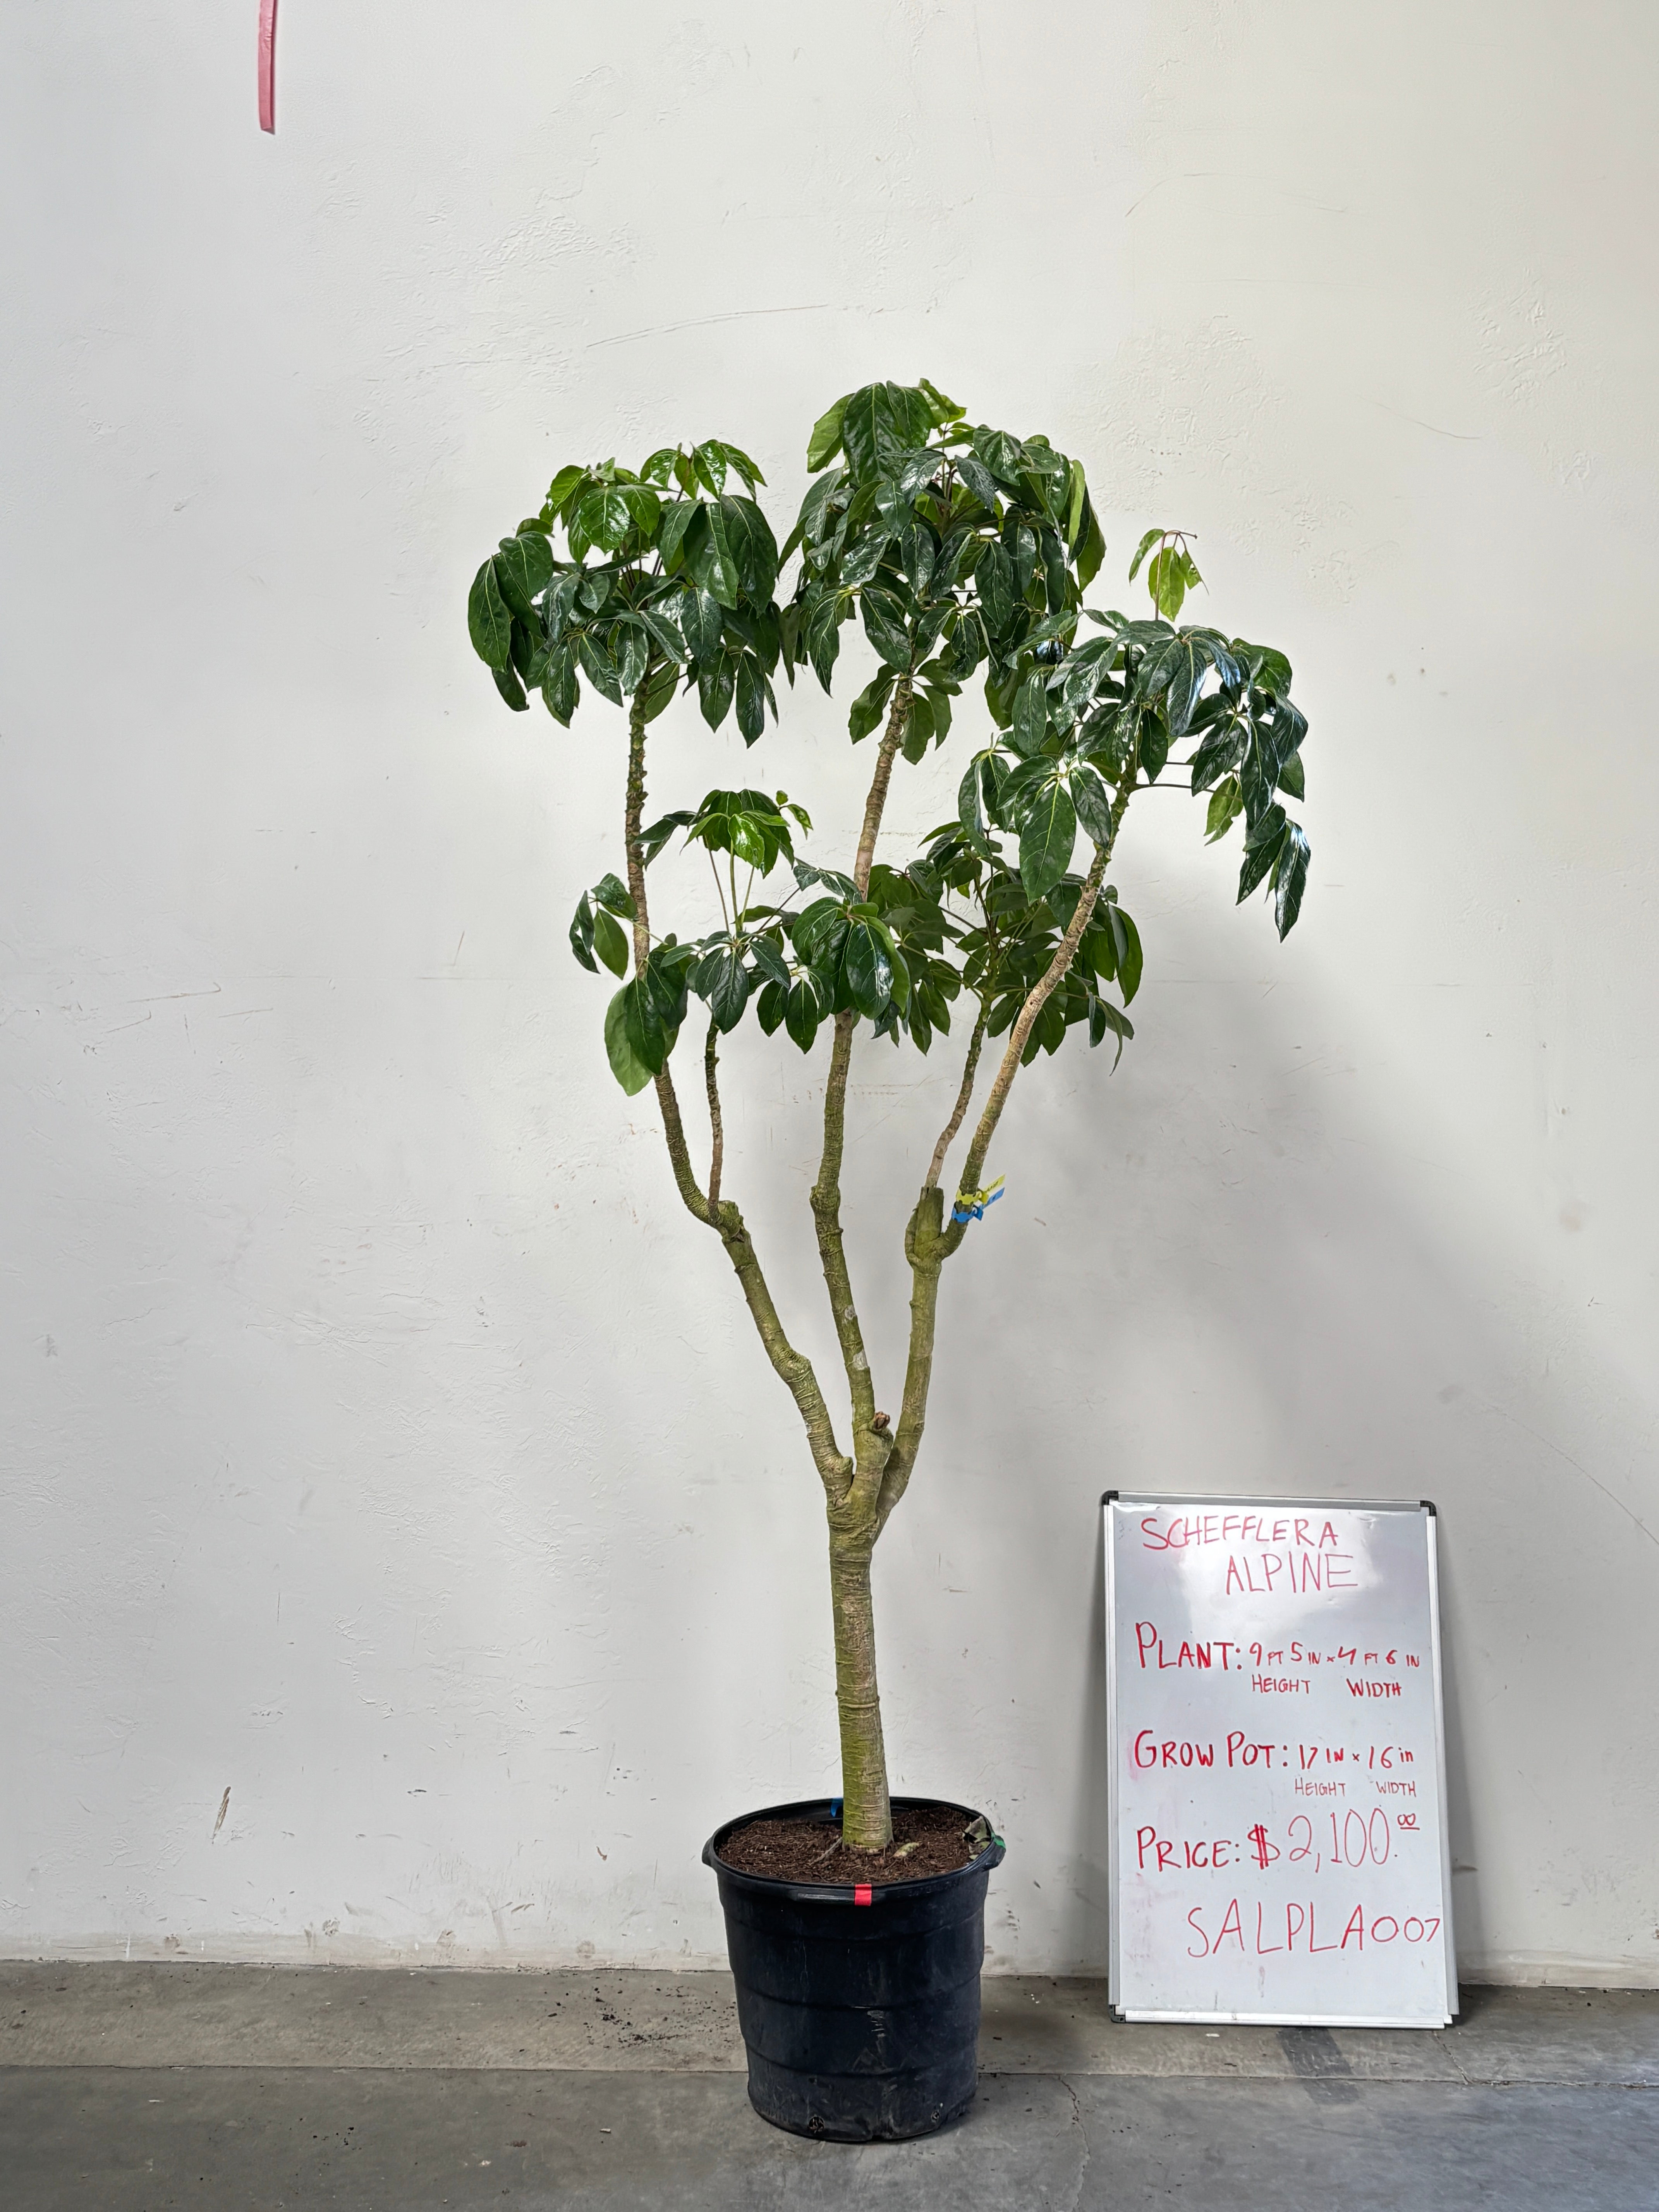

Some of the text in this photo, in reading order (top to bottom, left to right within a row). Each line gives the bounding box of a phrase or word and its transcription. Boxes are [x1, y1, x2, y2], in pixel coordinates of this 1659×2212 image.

[1140, 1516, 1337, 1551] SCHEFFLERA
[1226, 1552, 1358, 1595] ALPINE
[1135, 1622, 1242, 1671] PLANT:
[1249, 1642, 1262, 1667] 9
[1290, 1642, 1303, 1662] 5
[1308, 1652, 1321, 1665] IN
[1337, 1647, 1357, 1664] 4
[1364, 1652, 1378, 1664] FT
[1385, 1649, 1398, 1665] 6
[1406, 1656, 1419, 1667] IN
[1252, 1674, 1402, 1698] HEIGHT WIDTH
[1133, 1730, 1214, 1769] GROW
[1226, 1731, 1287, 1769] POT:
[1299, 1745, 1318, 1769] 17
[1326, 1748, 1344, 1763] IN
[1369, 1746, 1394, 1769] 16
[1398, 1747, 1414, 1762] in
[1295, 1777, 1417, 1797] HEIGHT WIDTH
[1137, 1826, 1239, 1872] PRICE:
[1187, 1899, 1440, 1957] SALPLA007
